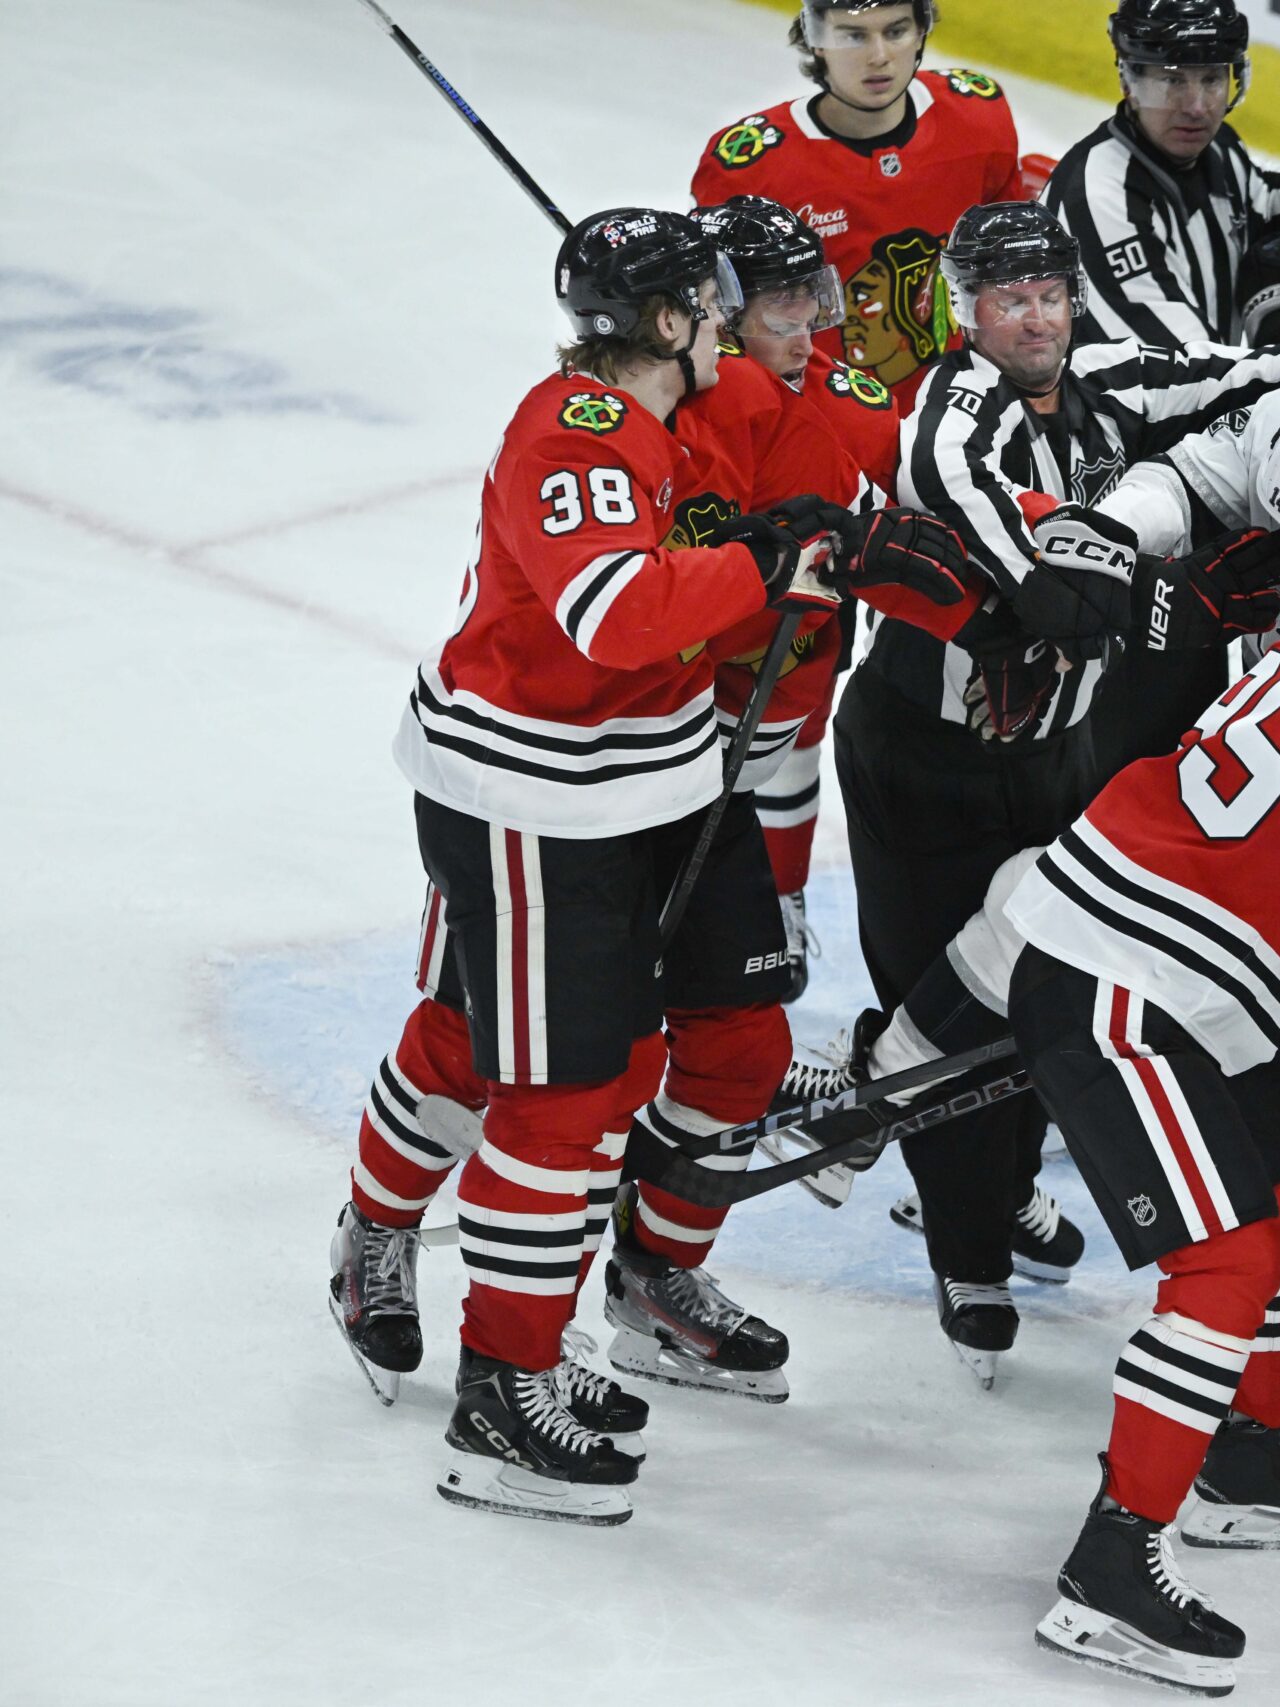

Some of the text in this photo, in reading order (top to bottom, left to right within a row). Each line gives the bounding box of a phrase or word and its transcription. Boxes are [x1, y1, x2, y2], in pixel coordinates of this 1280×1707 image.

[624, 215, 657, 231] BELLE
[630, 228, 658, 239] TIRE
[796, 204, 849, 229] Circa
[786, 249, 818, 265] BAUER
[1105, 241, 1149, 279] 50
[946, 388, 983, 415] 70
[540, 466, 639, 537] 38
[1045, 536, 1136, 578] CCM
[720, 1087, 856, 1150] CCM
[857, 1076, 1018, 1148] VAPOR
[469, 1411, 535, 1470] CCM
